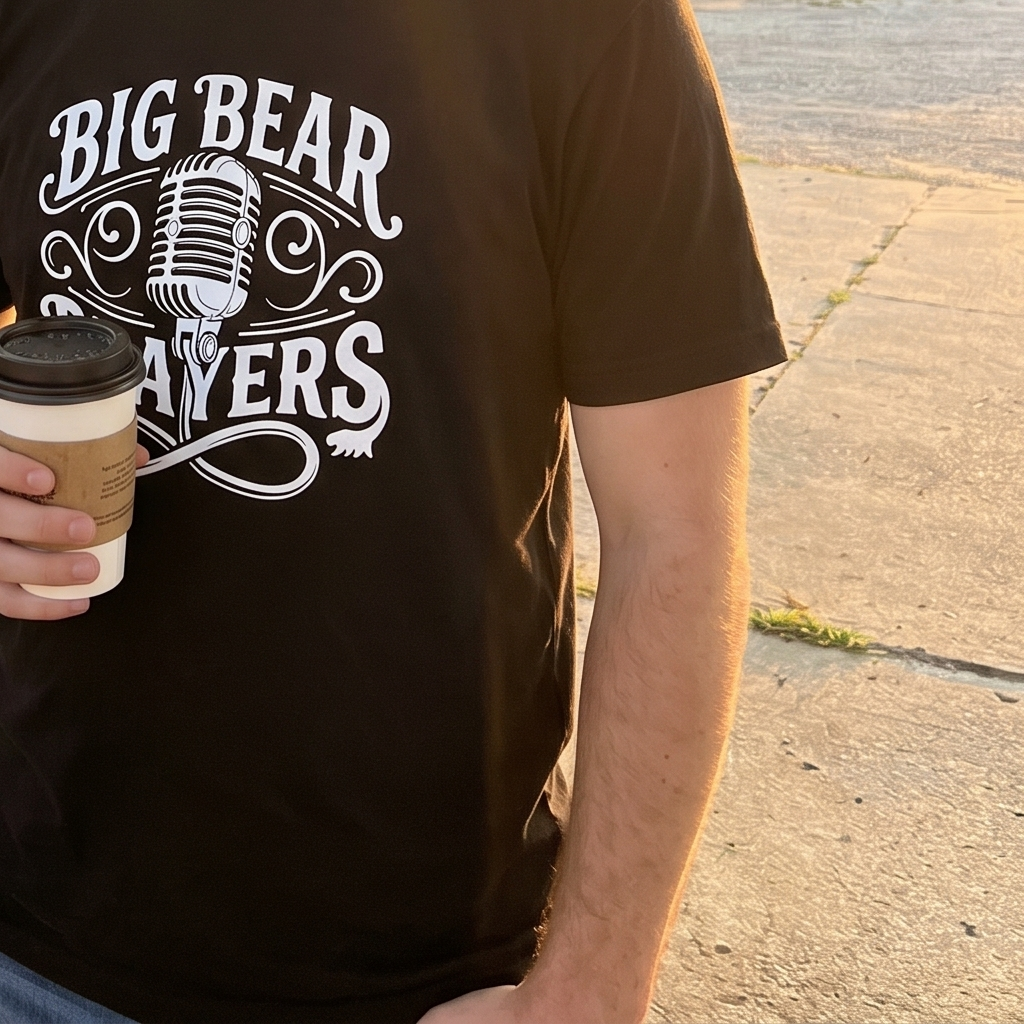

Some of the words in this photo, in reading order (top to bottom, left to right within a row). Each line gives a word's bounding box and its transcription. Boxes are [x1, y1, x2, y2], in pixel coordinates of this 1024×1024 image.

[39, 78, 177, 215] BIG
[193, 74, 403, 240] BEAR
[40, 294, 390, 458] AYERS
